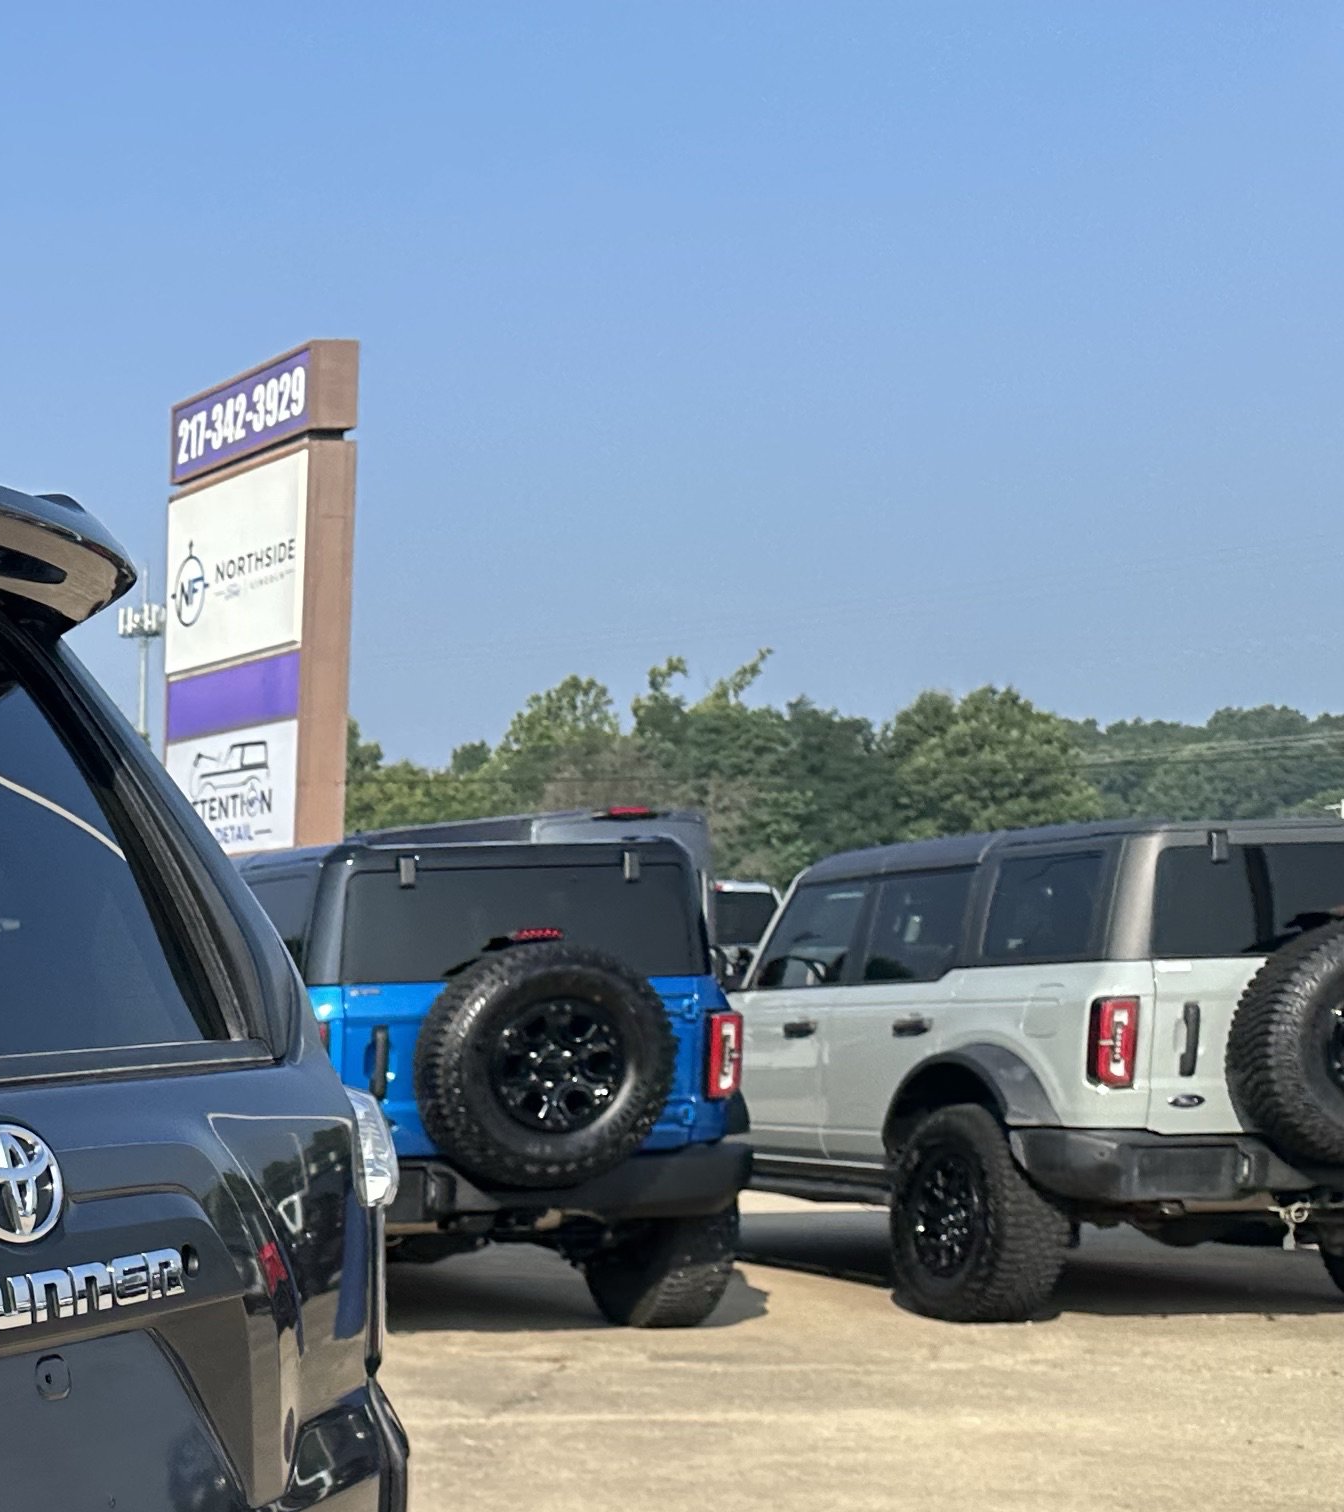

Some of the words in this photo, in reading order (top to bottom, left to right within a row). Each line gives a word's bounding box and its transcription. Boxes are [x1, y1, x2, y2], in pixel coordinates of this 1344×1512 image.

[177, 366, 306, 465] 217-342-3929
[215, 538, 296, 583] NORTHSIDE
[191, 788, 273, 821] TENTION
